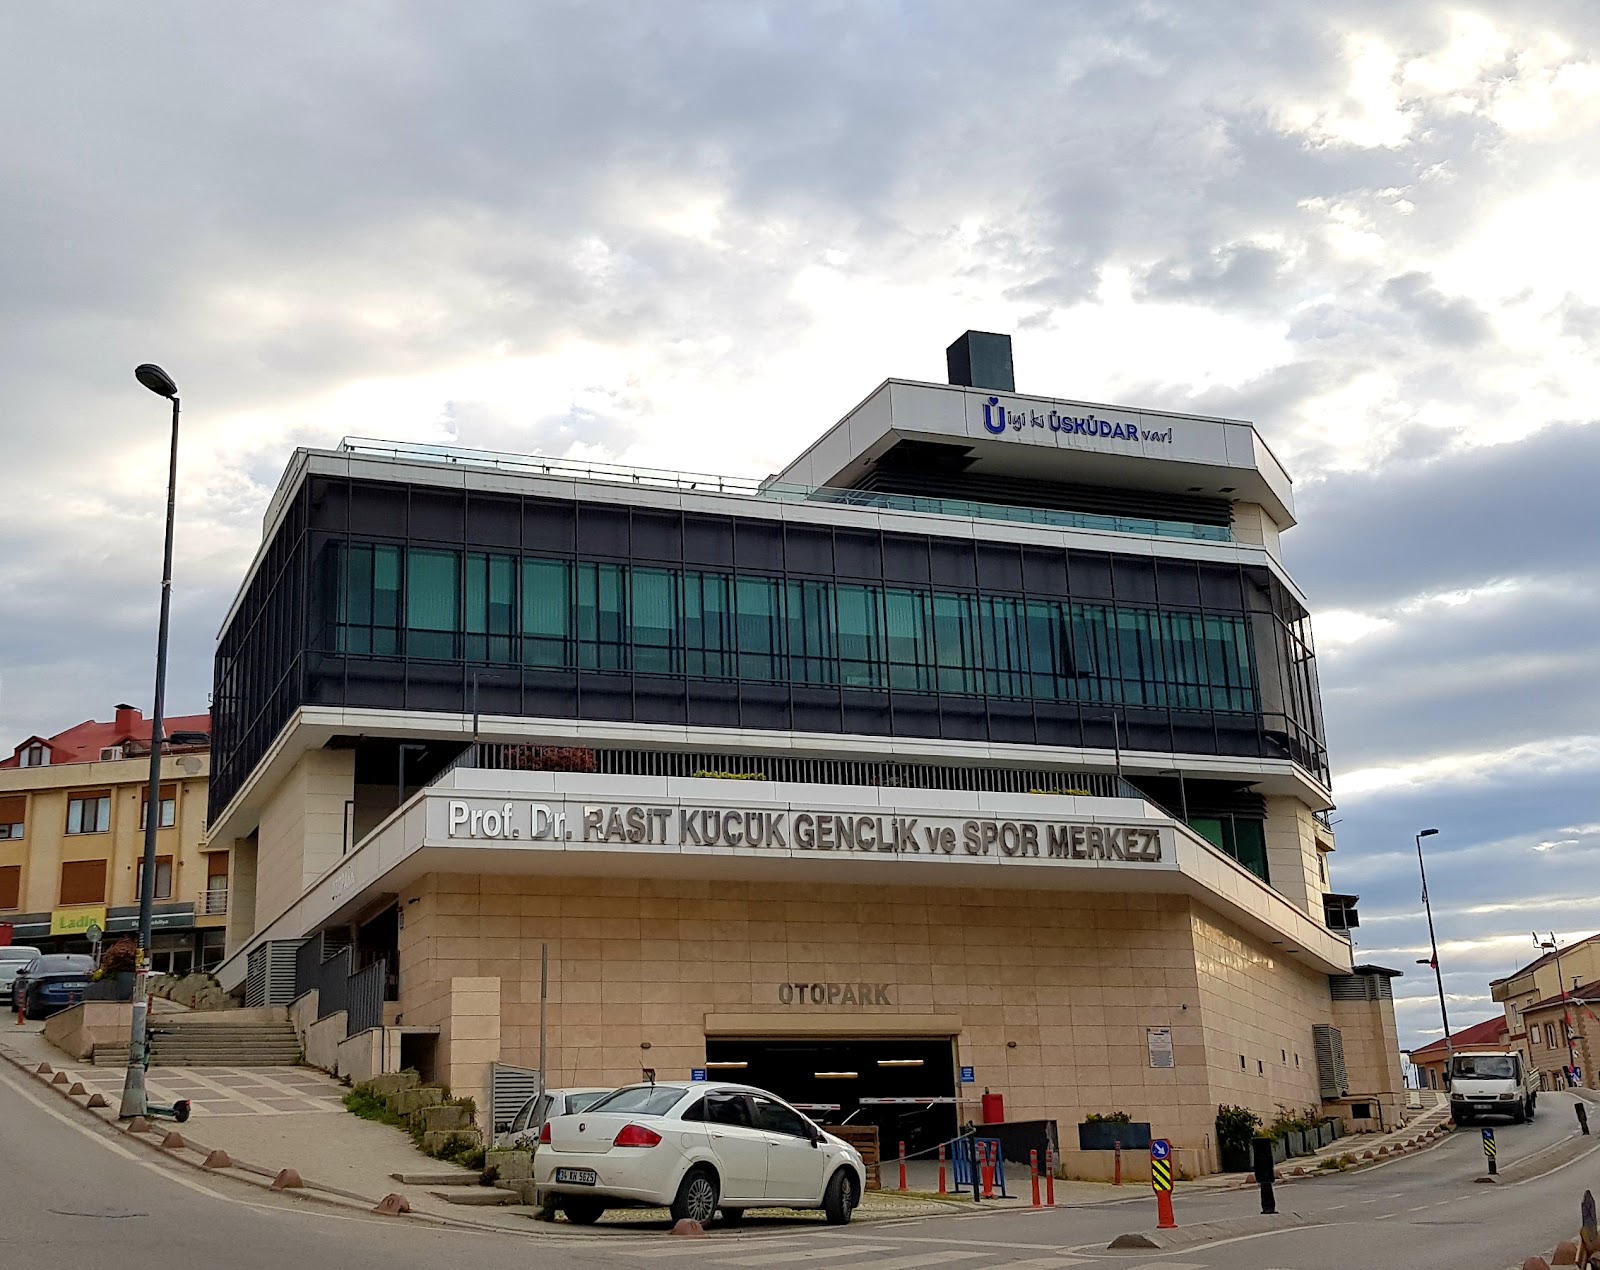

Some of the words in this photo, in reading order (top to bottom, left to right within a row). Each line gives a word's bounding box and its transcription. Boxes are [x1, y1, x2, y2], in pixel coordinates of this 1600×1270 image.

[1030, 409, 1045, 428] ki
[1141, 427, 1172, 443] var!
[449, 800, 519, 838] Prof.
[531, 803, 572, 840] Dr.
[924, 826, 956, 854] ve
[962, 820, 1040, 856] SPOR
[778, 982, 891, 1005] OTOPARK
